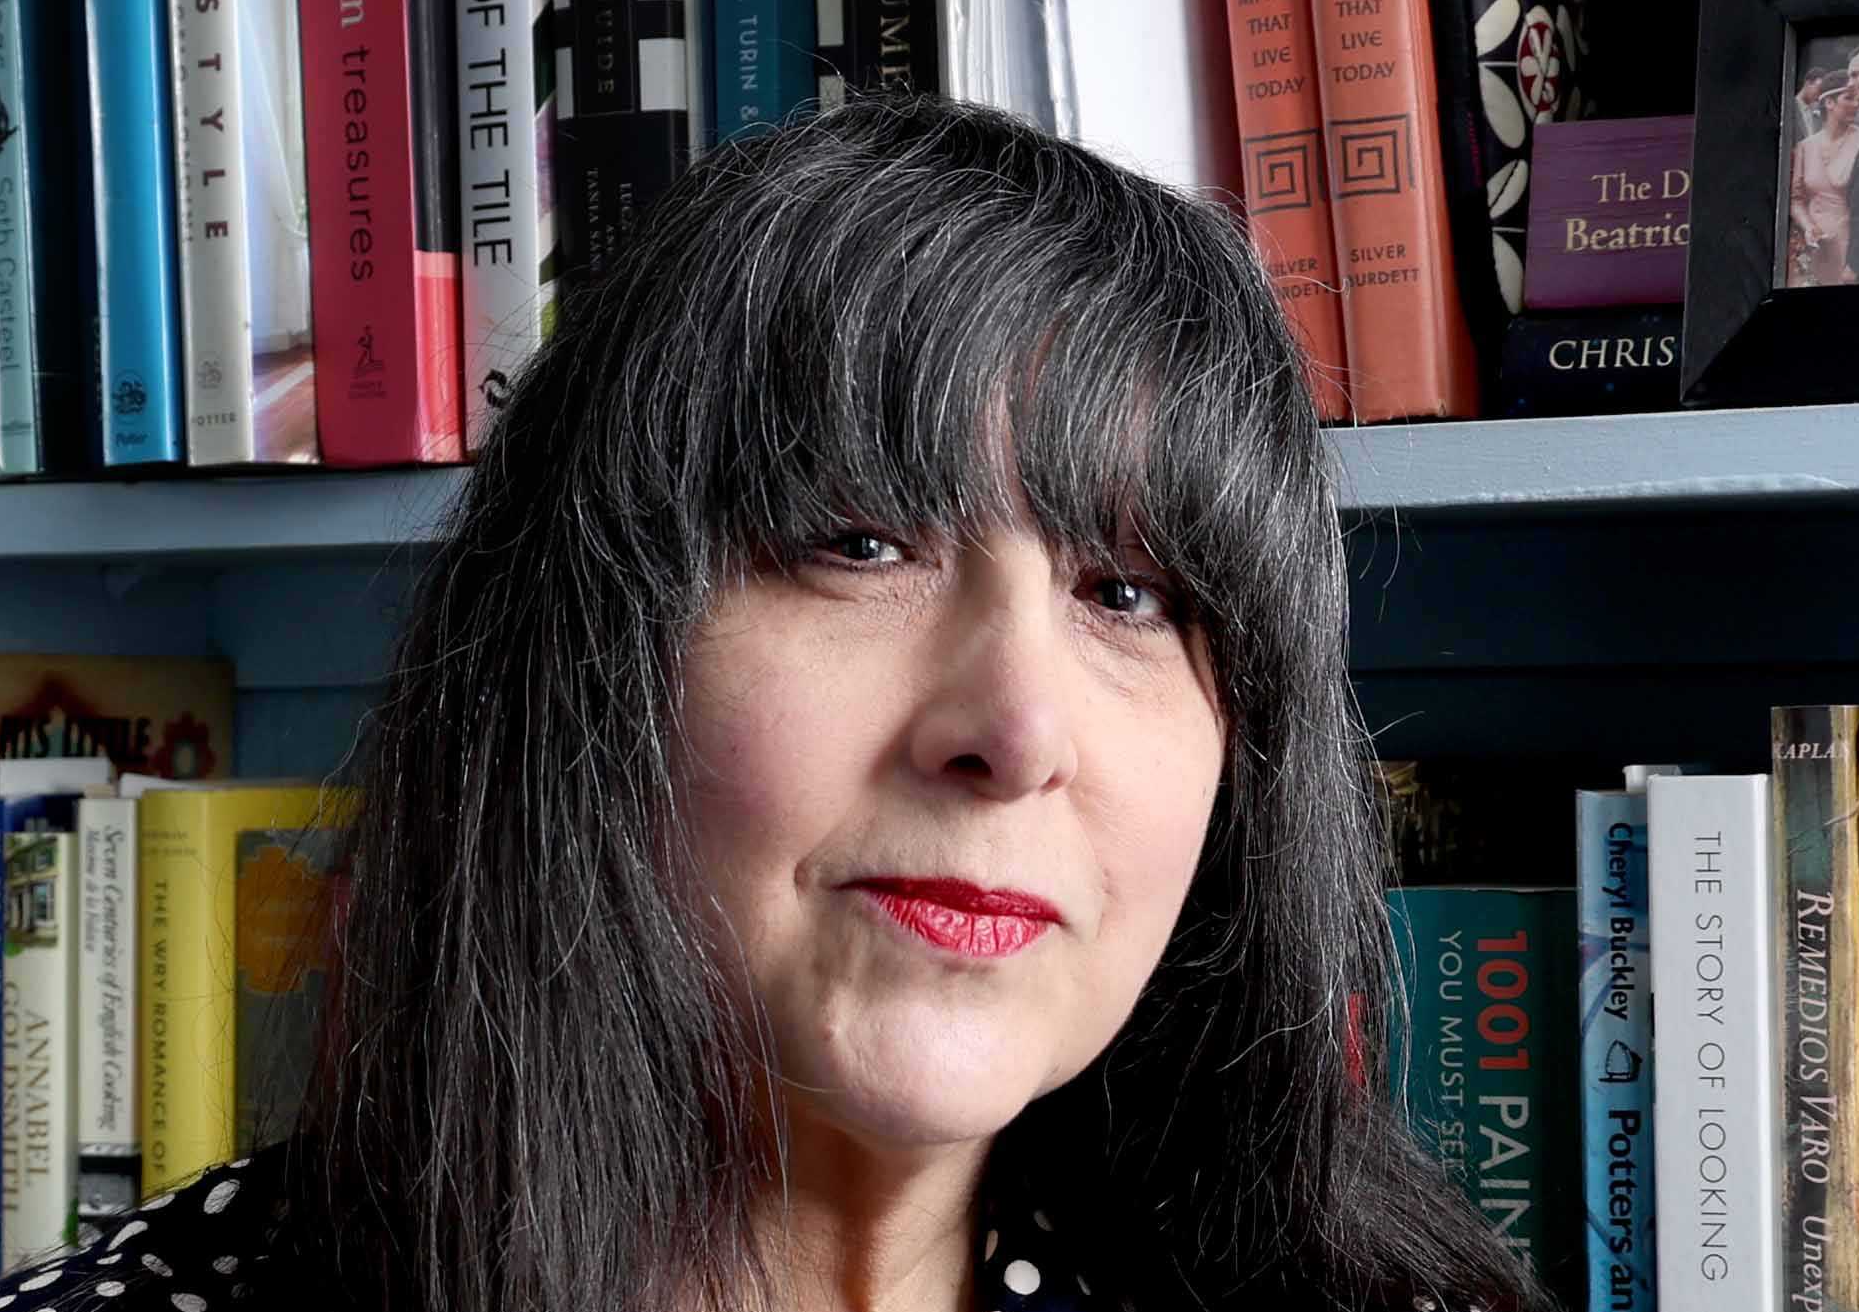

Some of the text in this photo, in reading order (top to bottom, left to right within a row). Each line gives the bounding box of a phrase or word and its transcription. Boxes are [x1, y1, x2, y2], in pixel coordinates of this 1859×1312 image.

[1332, 58, 1395, 84] TODAY
[1341, 28, 1382, 50] LIVE
[469, 48, 510, 149] THE
[341, 45, 375, 282] treasures
[472, 169, 511, 267] TILE
[1694, 831, 1722, 895] THE
[1696, 915, 1724, 1025] STORY
[1698, 1043, 1725, 1088] OF
[1797, 890, 1836, 1184] REMEDIOS VARO
[1698, 1106, 1728, 1282] LOOKING
